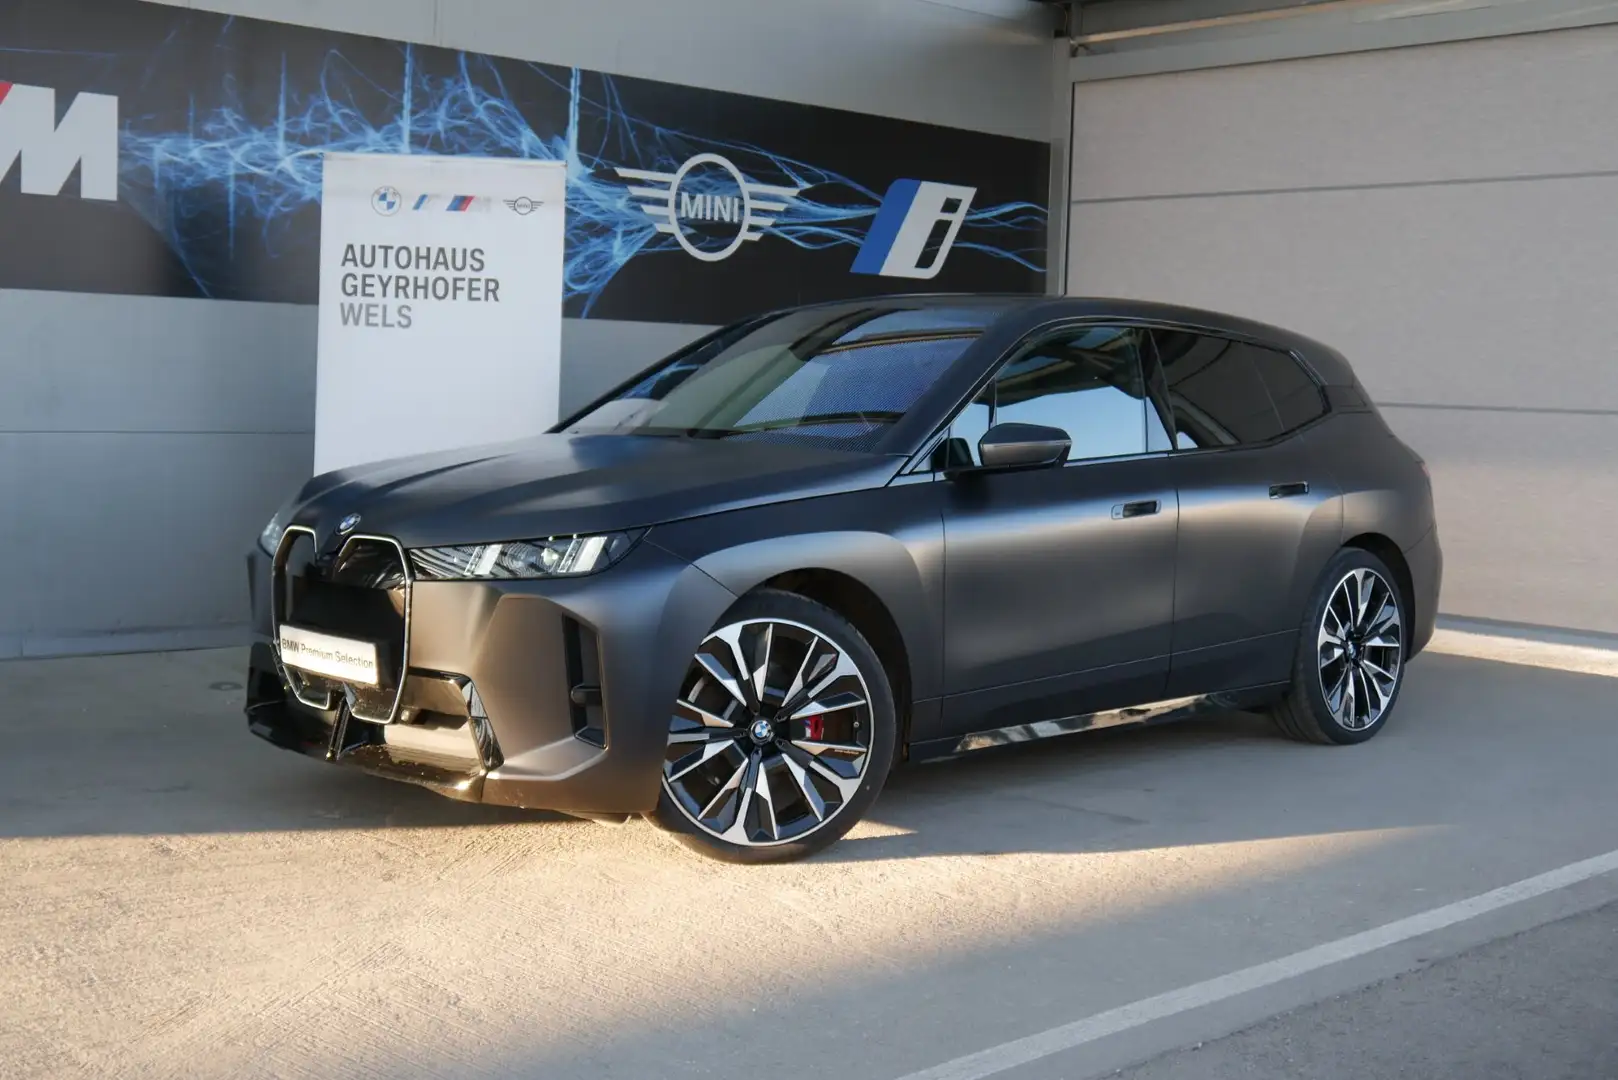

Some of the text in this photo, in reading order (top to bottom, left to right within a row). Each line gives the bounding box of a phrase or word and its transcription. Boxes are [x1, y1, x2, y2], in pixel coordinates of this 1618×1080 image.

[680, 191, 739, 223] MINI
[341, 243, 485, 272] AUTOHAUS
[341, 272, 500, 302] GEYRHOFER
[340, 302, 412, 329] WELS
[282, 638, 374, 669] BMW Premium Selection
